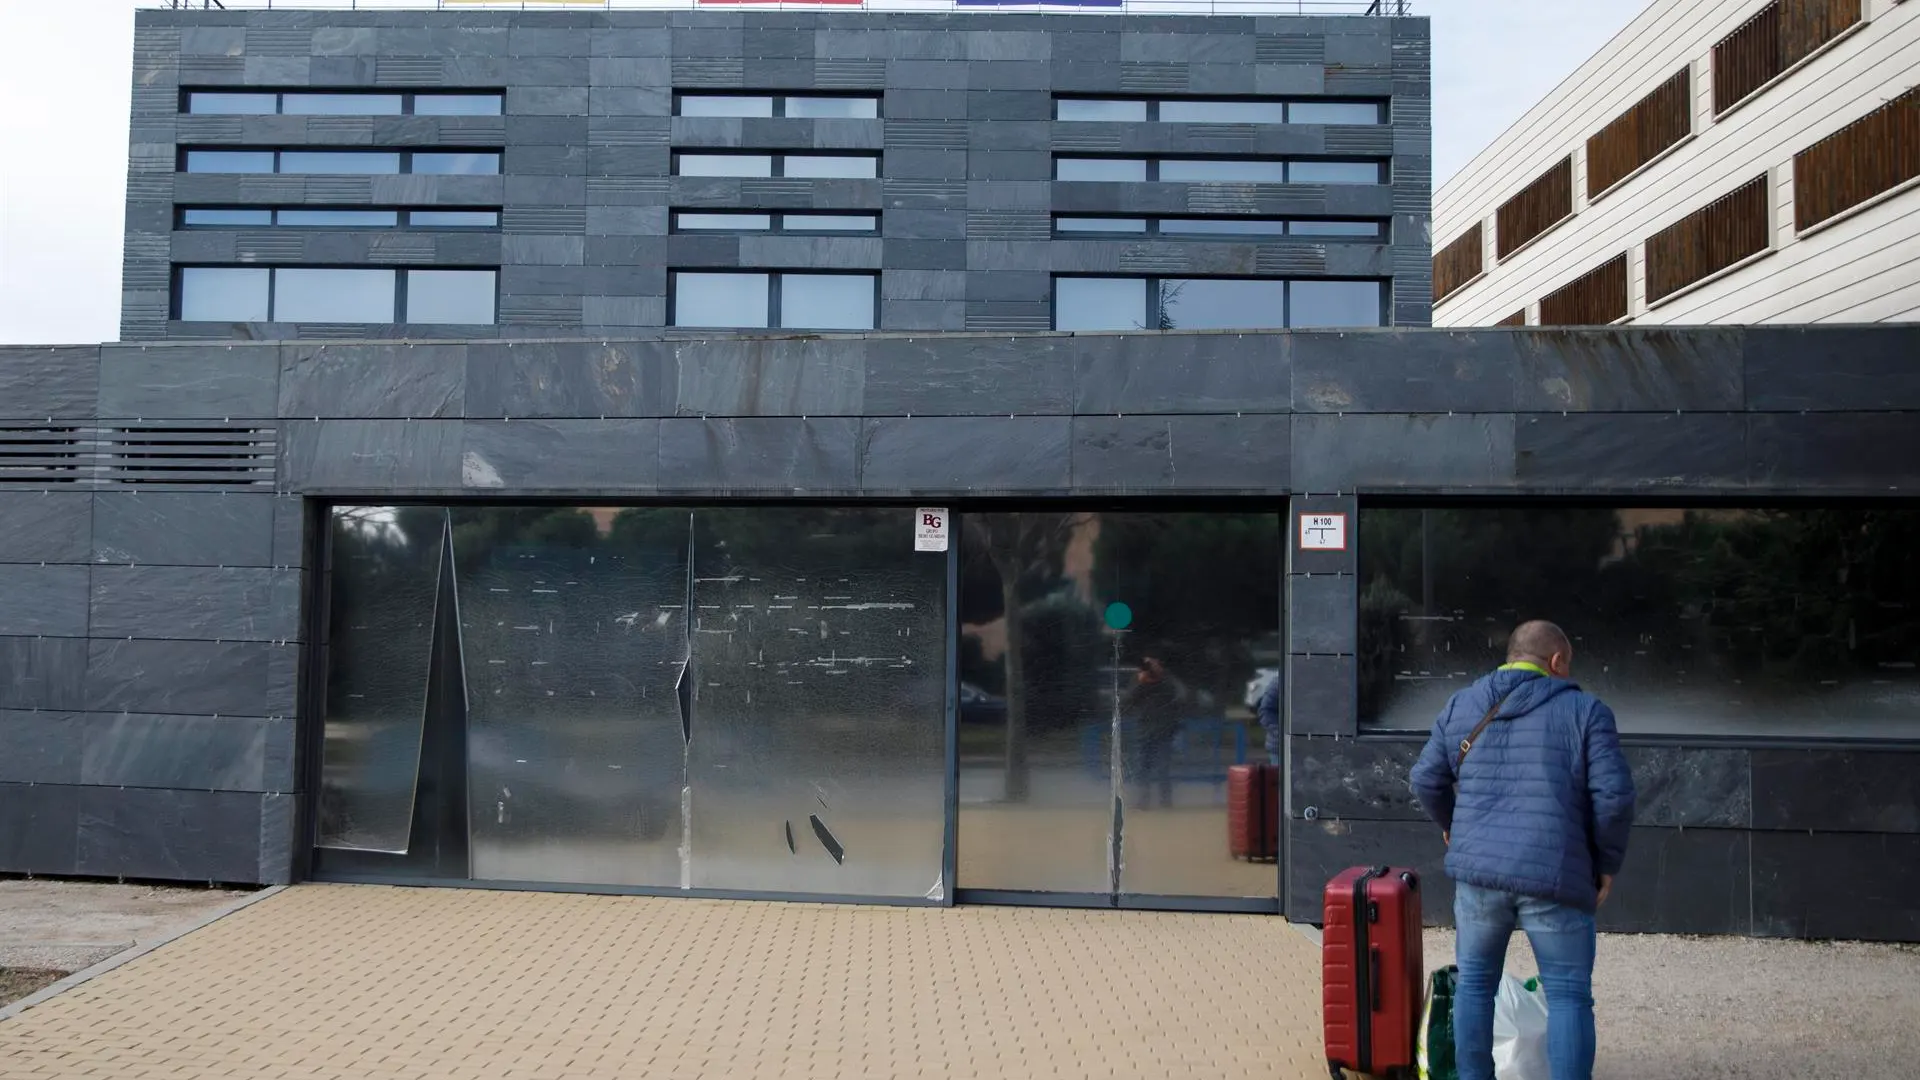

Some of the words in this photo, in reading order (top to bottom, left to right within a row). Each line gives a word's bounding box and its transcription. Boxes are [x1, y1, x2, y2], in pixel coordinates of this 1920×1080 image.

[923, 513, 942, 528] BG
[1313, 517, 1318, 525] H
[1320, 517, 1332, 526] 100
